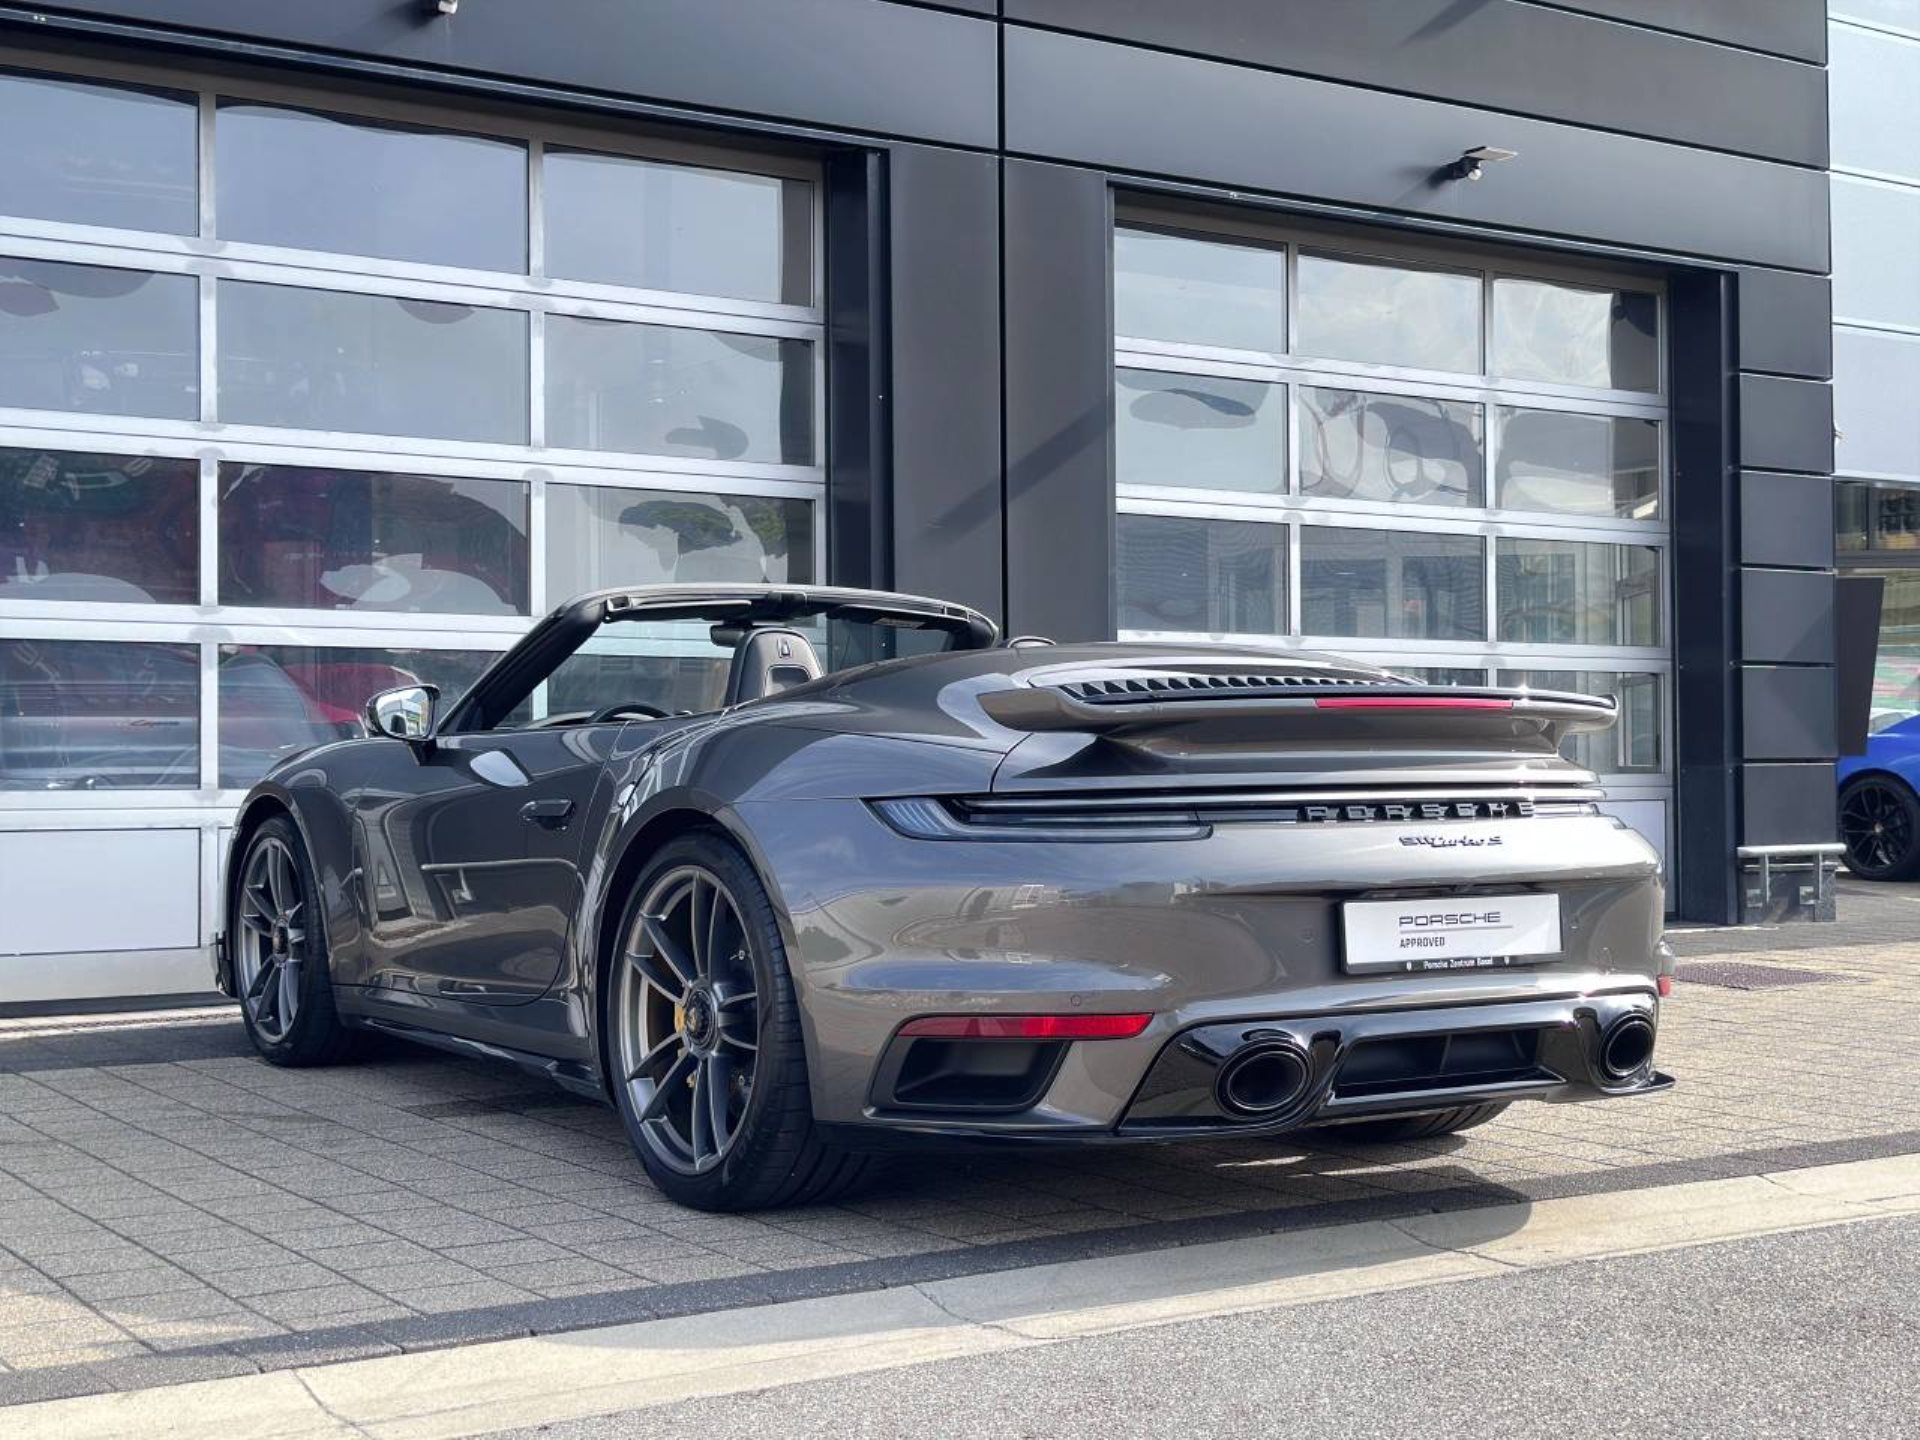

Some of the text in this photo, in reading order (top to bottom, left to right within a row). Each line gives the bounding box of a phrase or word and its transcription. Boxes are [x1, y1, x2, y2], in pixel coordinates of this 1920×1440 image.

[1305, 802, 1535, 821] PORSCHE
[1487, 836, 1503, 847] S
[1398, 911, 1501, 927] PORSCHE
[1399, 936, 1446, 948] APPROVED
[1423, 960, 1448, 970] Porsche
